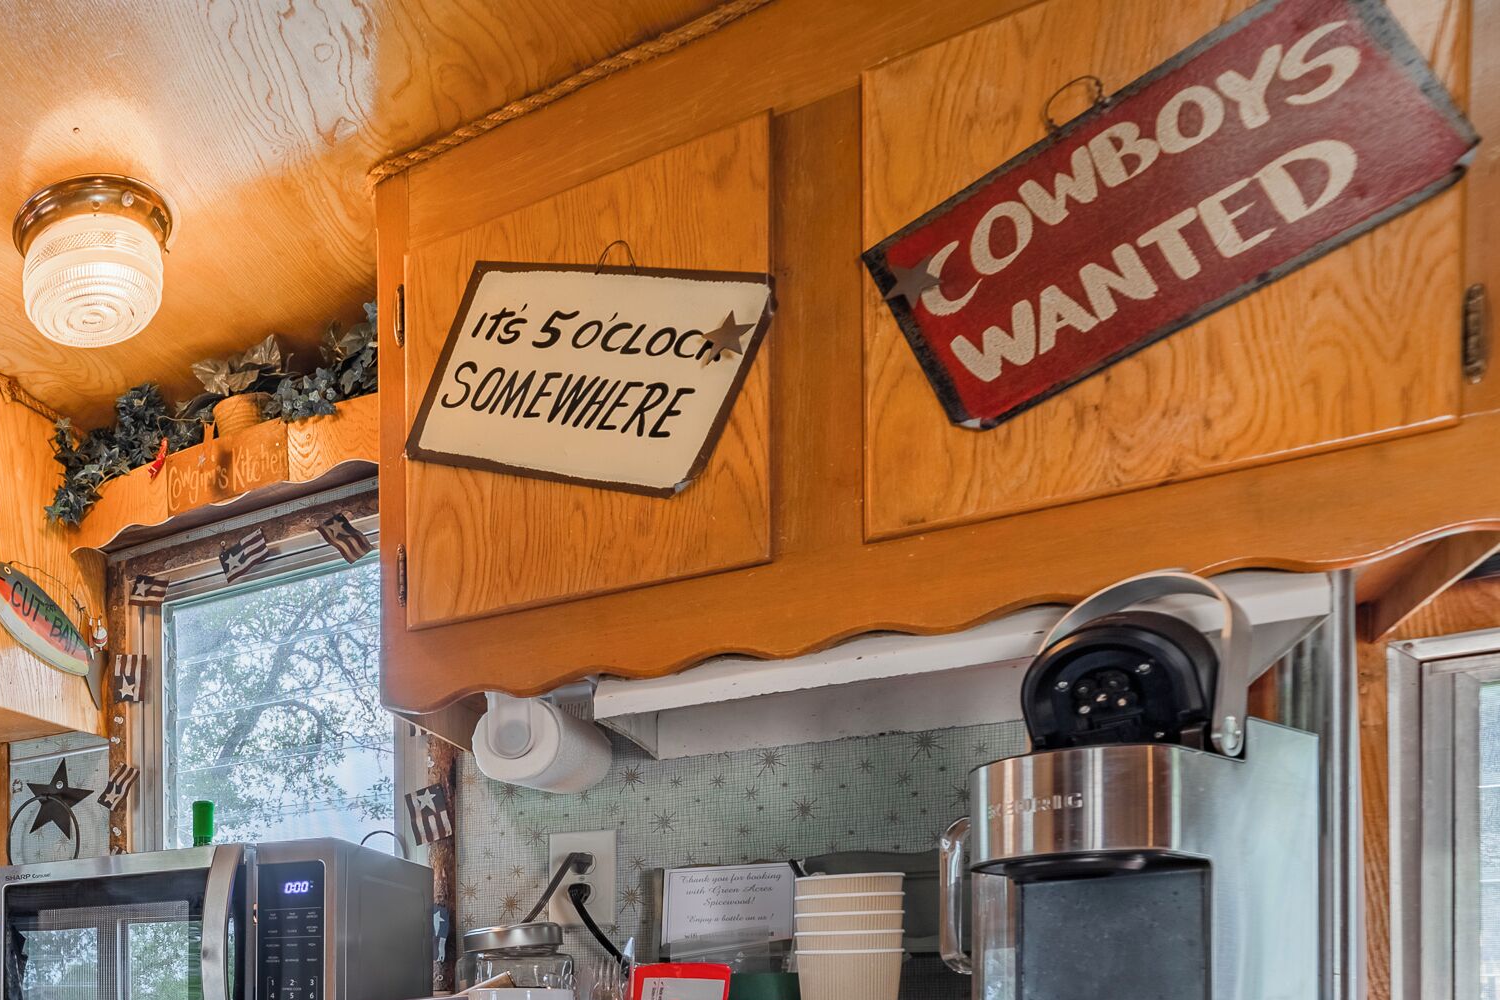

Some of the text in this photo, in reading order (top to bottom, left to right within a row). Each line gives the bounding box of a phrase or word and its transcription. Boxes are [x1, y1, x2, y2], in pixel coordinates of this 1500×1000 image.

[921, 20, 1361, 316] COWBOYS
[950, 140, 1357, 383] WANTED
[531, 310, 580, 349] 5
[441, 361, 695, 438] SOMEWHERE
[232, 443, 288, 491] Kitchen
[11, 581, 80, 655] CUT BAIT
[284, 881, 309, 894] 0:00
[686, 884, 773, 896] with Green Acres
[712, 876, 728, 884] you
[730, 873, 744, 883] for
[746, 872, 782, 881] booking
